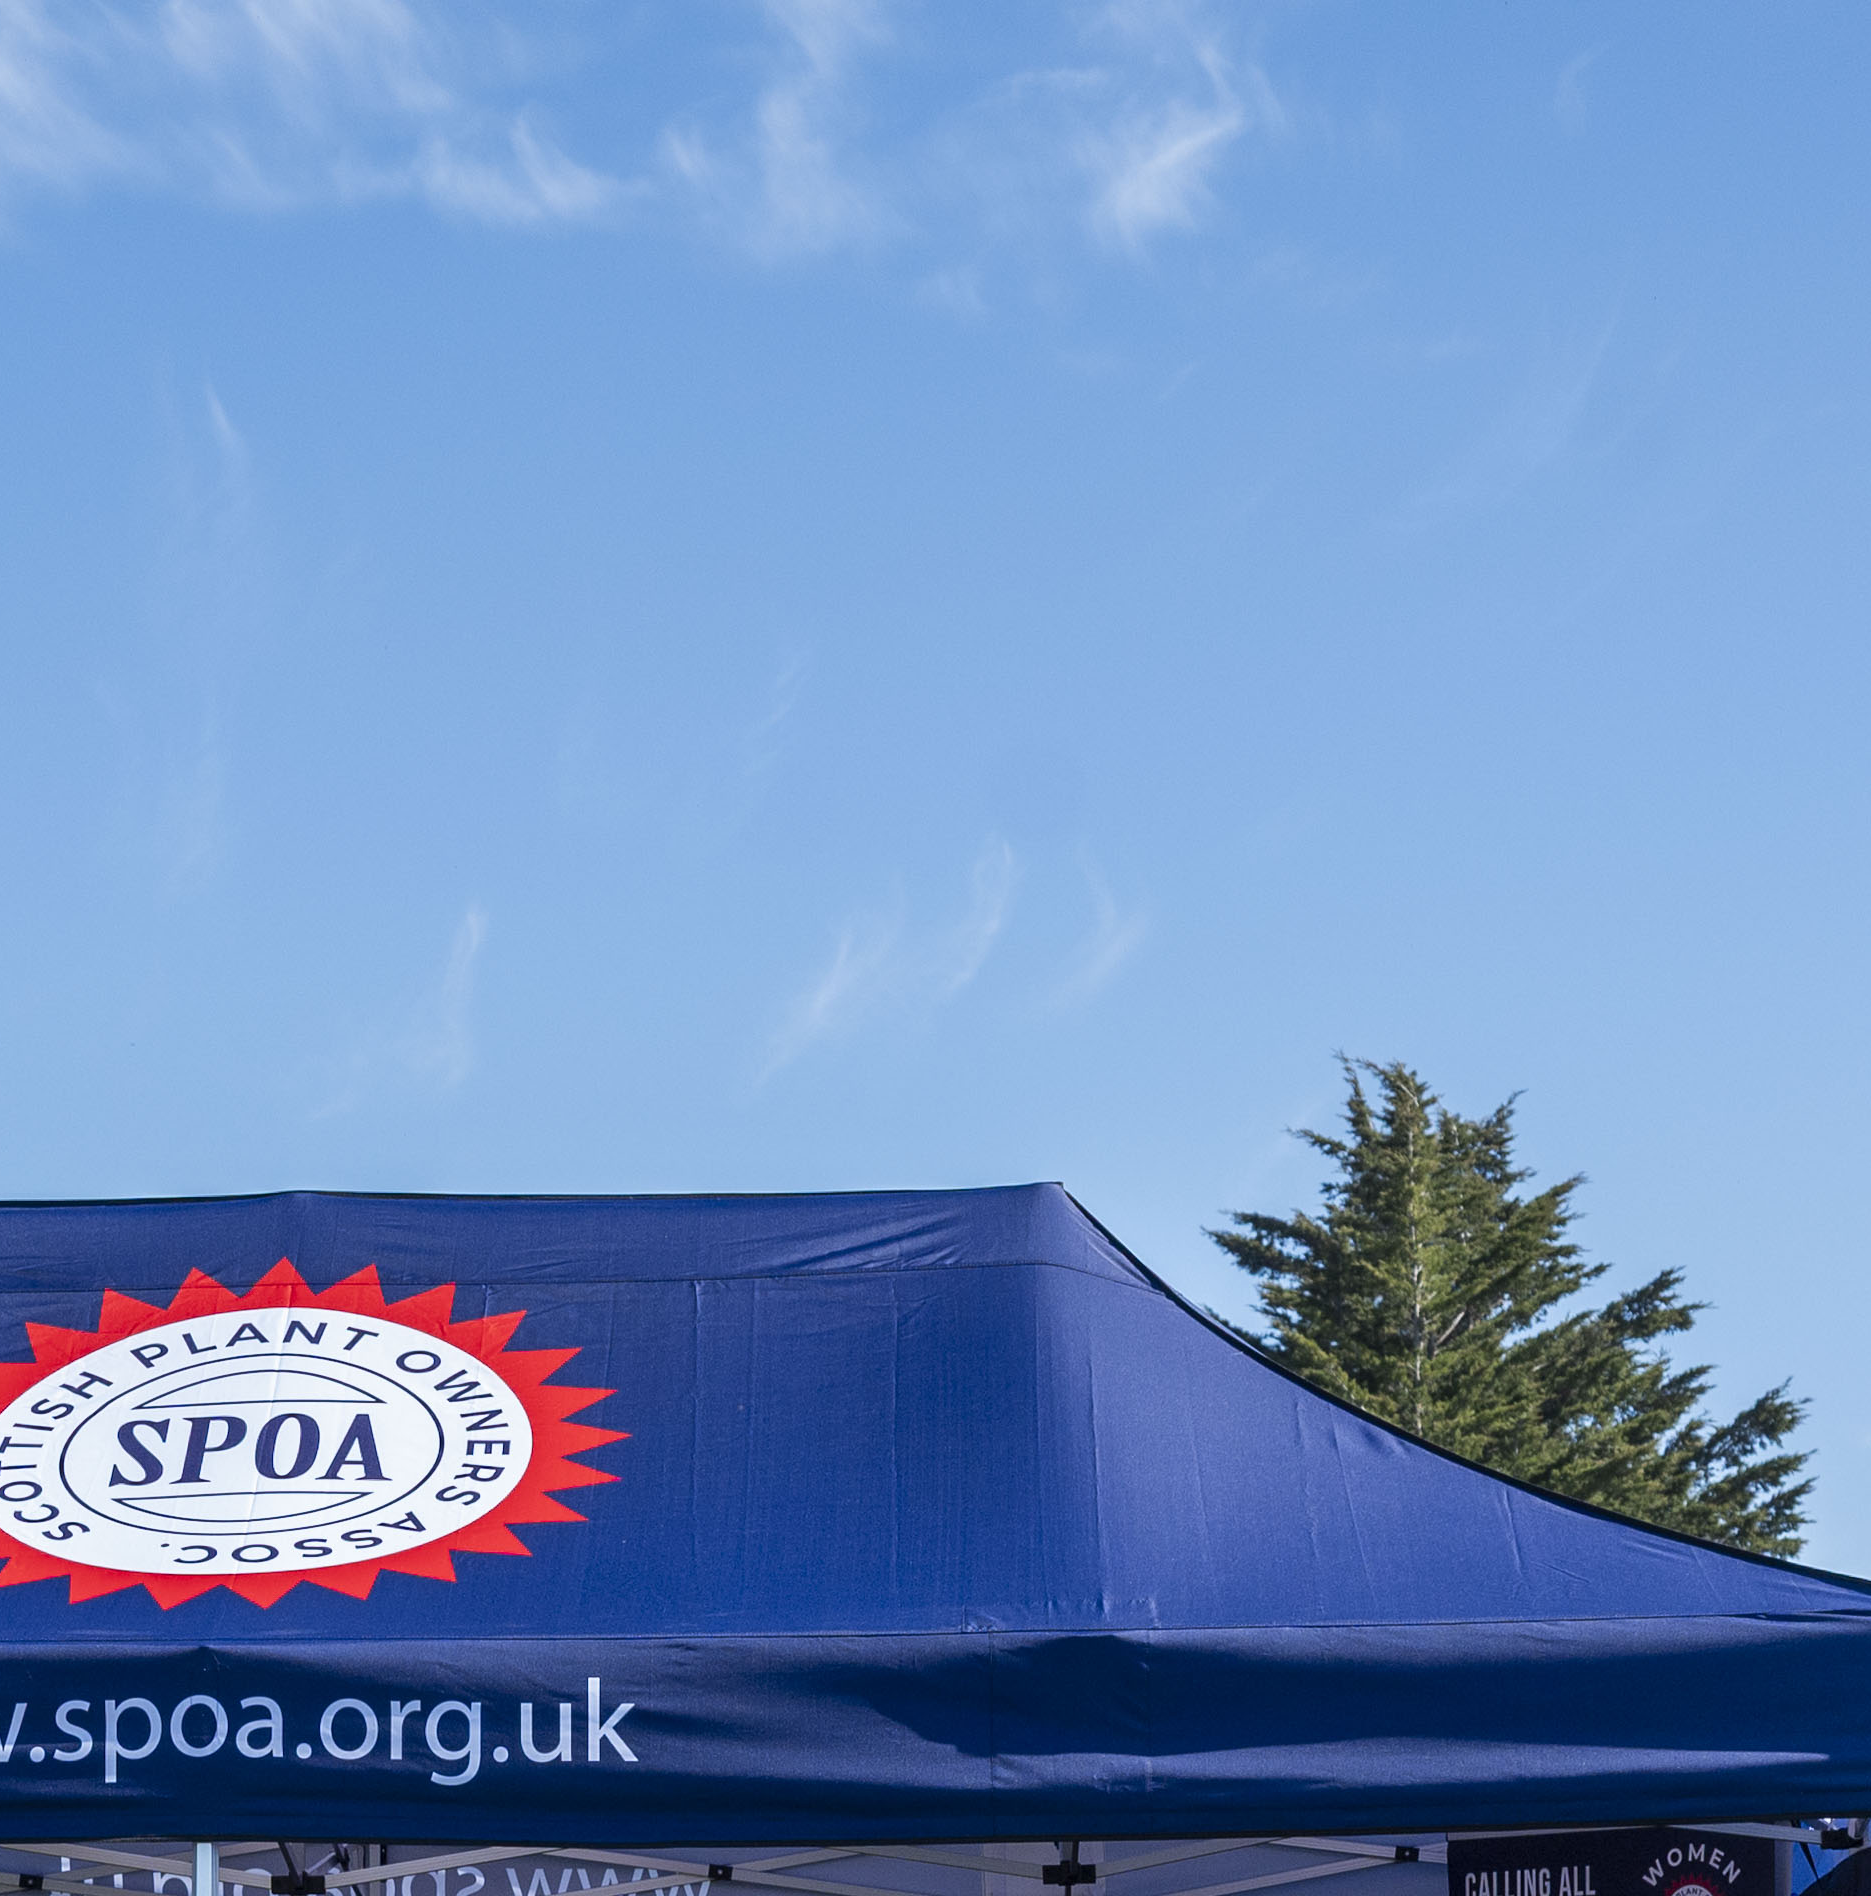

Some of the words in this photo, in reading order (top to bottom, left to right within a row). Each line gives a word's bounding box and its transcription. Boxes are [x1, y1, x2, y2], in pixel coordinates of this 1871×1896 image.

[131, 1320, 379, 1370] PLANT
[108, 1412, 392, 1487] SPOA
[396, 1349, 512, 1509] OWNERS
[159, 1511, 427, 1564] ASSOC.
[1642, 1842, 1741, 1887] WOMEN
